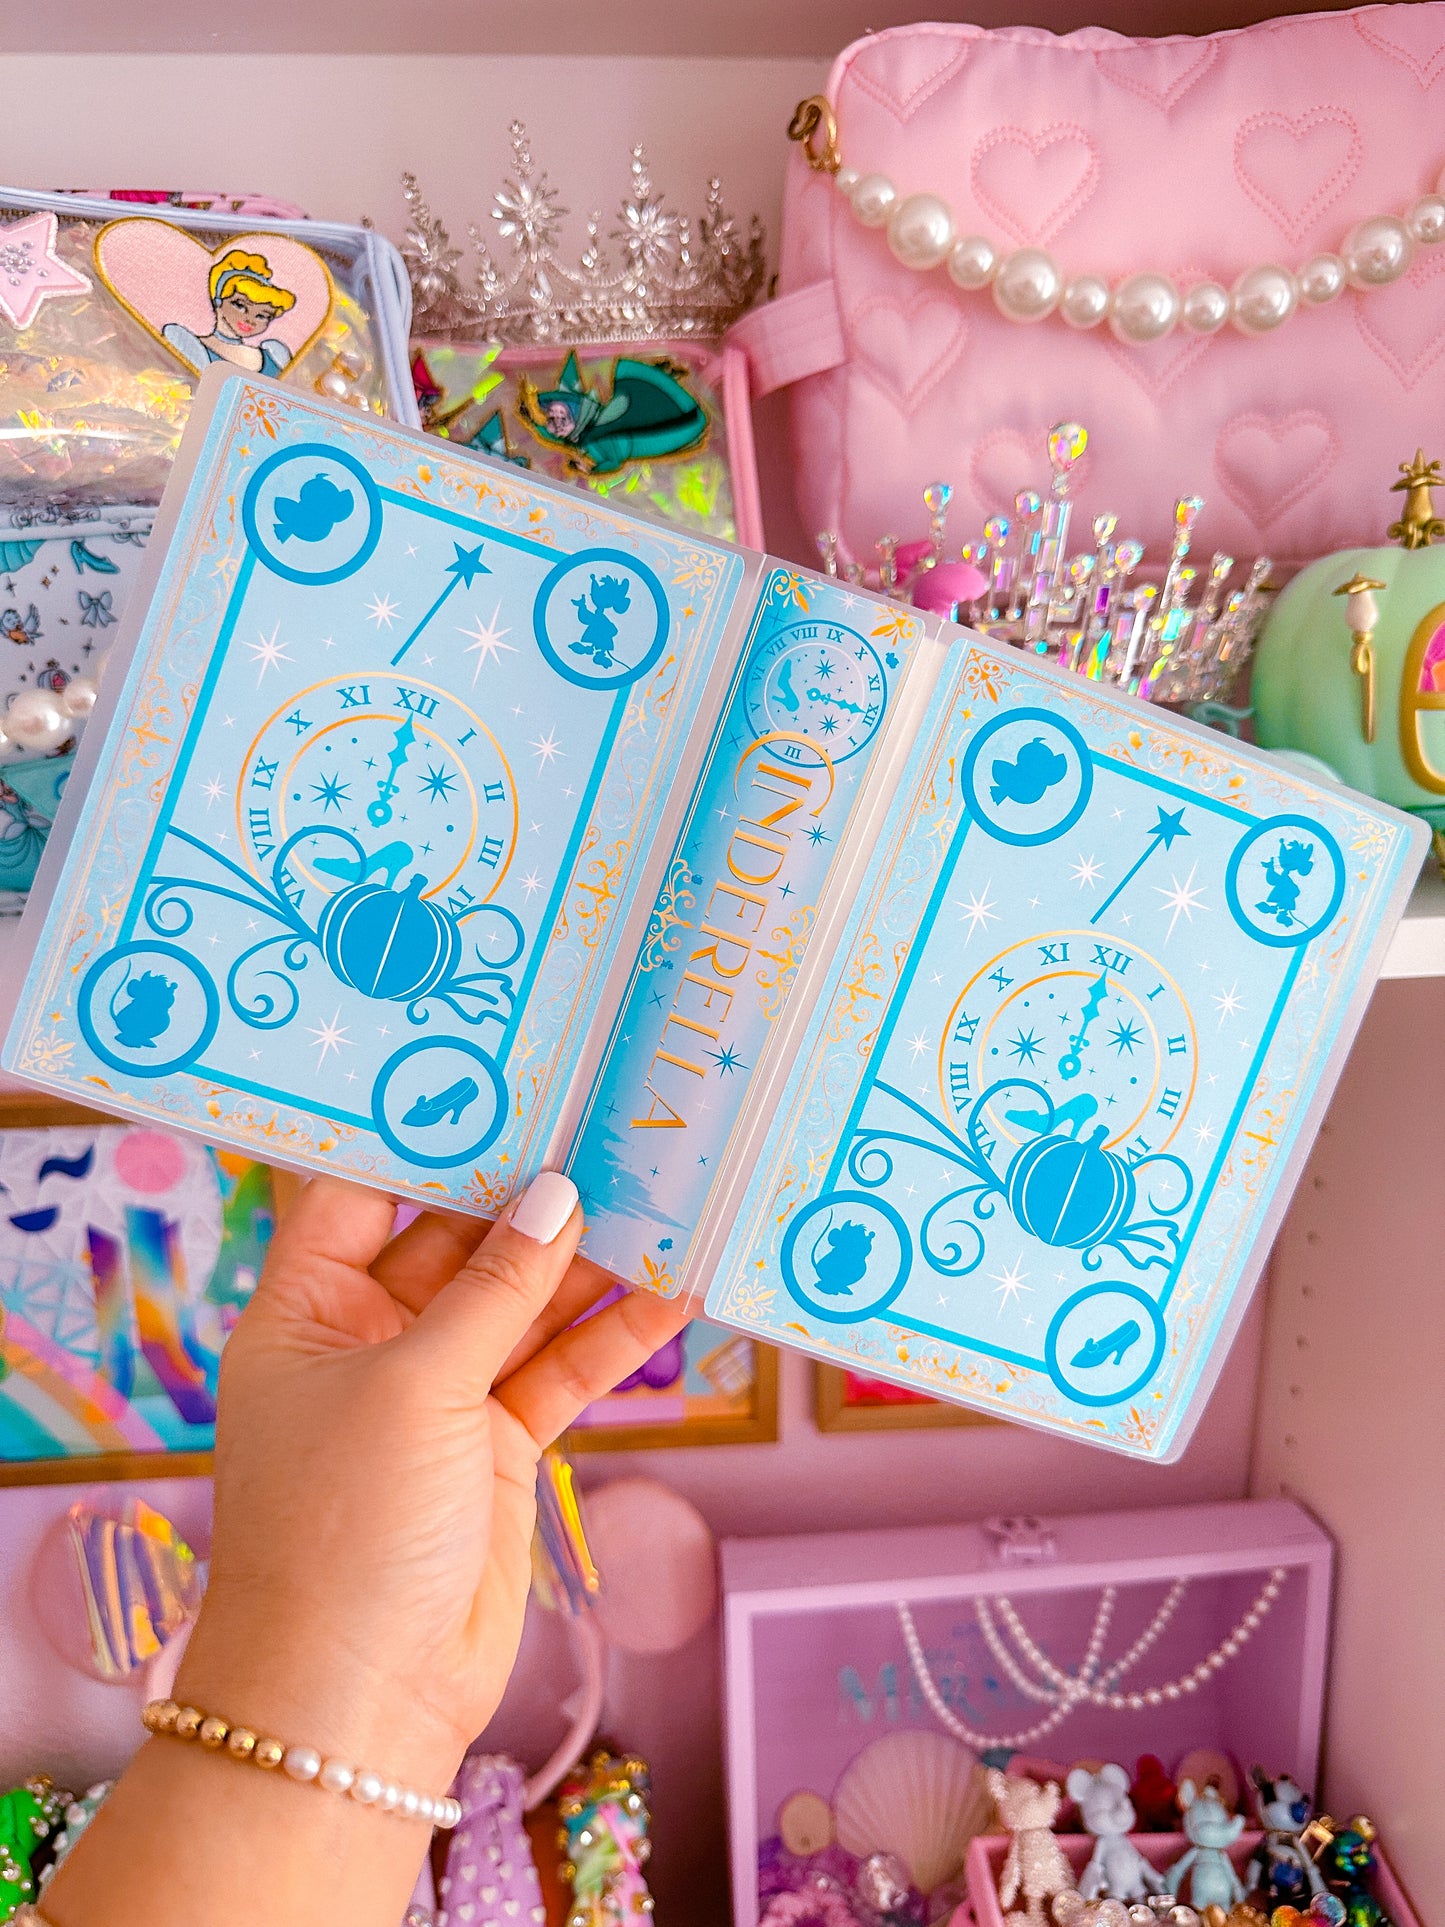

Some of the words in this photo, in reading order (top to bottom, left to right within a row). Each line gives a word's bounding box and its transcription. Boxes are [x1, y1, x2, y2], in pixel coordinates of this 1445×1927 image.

[790, 626, 819, 641] VIII
[826, 628, 845, 644] IX
[767, 638, 787, 657] VII
[854, 646, 868, 661] X
[867, 673, 881, 692] XI
[336, 685, 372, 709] XI
[393, 686, 441, 720] XII
[284, 709, 313, 736] X
[862, 703, 880, 728] XII
[457, 727, 478, 747] I
[847, 735, 858, 747] I
[784, 745, 802, 760] III
[251, 755, 280, 791] IX
[483, 780, 506, 804] II
[249, 807, 276, 862] VIII
[477, 835, 505, 870] III
[628, 730, 835, 1129] CINDERELLA
[1037, 942, 1071, 966] XI
[1089, 944, 1134, 976] XII
[988, 966, 1015, 993] X
[1146, 983, 1166, 1002] I
[953, 1011, 981, 1046] IX
[1167, 1033, 1187, 1057] II
[949, 1061, 973, 1115] VIII
[1156, 1087, 1182, 1120] III
